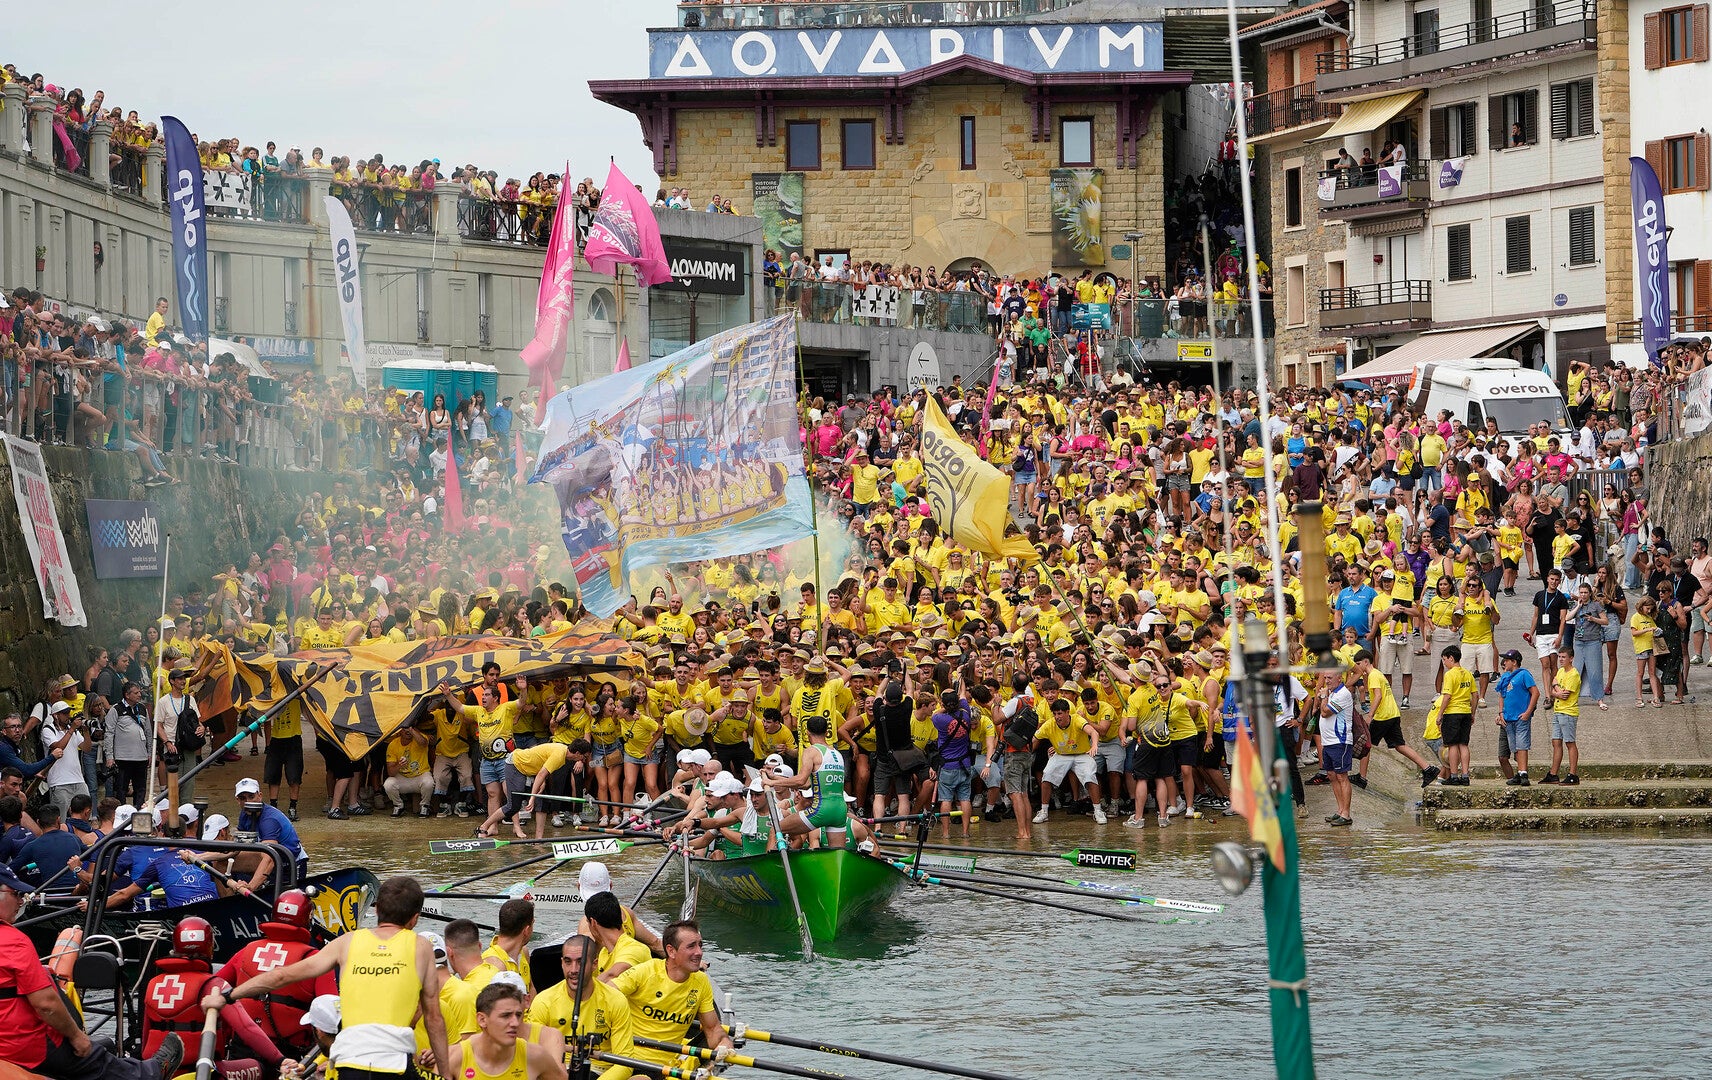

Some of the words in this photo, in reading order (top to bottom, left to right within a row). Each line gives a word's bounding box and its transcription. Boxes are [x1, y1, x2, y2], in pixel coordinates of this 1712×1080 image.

[1489, 384, 1550, 395] overon
[445, 841, 481, 851] boga
[554, 840, 618, 855] HIRUZTA
[1078, 853, 1133, 867] PREVITEK
[534, 894, 584, 903] TRAMEINSA
[352, 964, 399, 977] iraupen
[642, 1005, 694, 1025] ORIALKI
